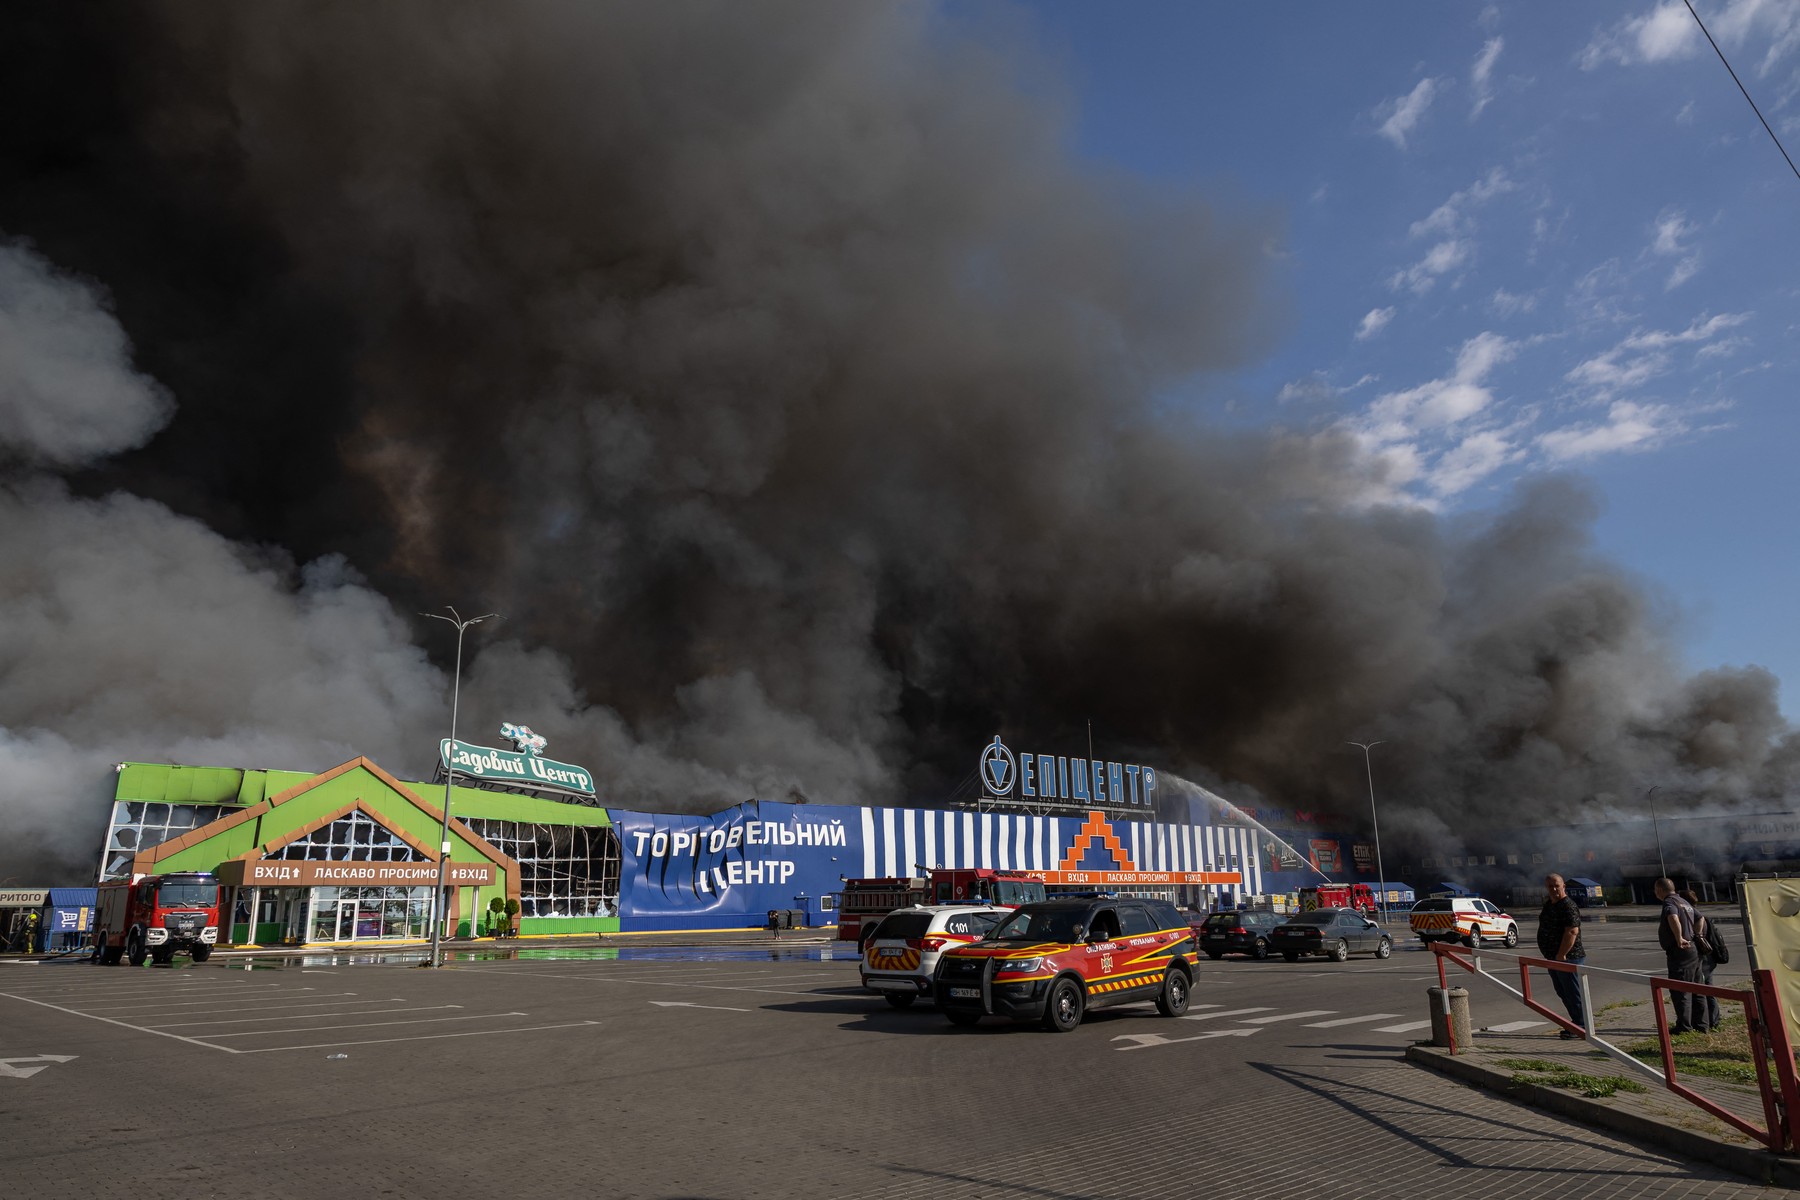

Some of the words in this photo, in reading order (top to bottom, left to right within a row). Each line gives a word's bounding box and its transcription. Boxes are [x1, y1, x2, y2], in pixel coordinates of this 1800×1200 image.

[443, 741, 525, 775] Садовий
[528, 757, 589, 791] Центр
[1020, 752, 1156, 805] ЕПІЦЕНТР
[633, 819, 847, 858] ТОРГОВЕЛЬНИЙ
[254, 866, 290, 880] ВХІД
[314, 867, 375, 879] ЛАСКАВО
[379, 868, 438, 879] ПРОСИМО
[459, 868, 488, 881] ВХІД
[700, 860, 795, 893] ЦЕНТР
[1068, 873, 1084, 883] ВХІД
[1107, 873, 1136, 883] ЛАСКАВО
[1138, 873, 1170, 882] ПРОСИМО!
[1188, 873, 1202, 883] ВХІД
[955, 922, 969, 933] 101
